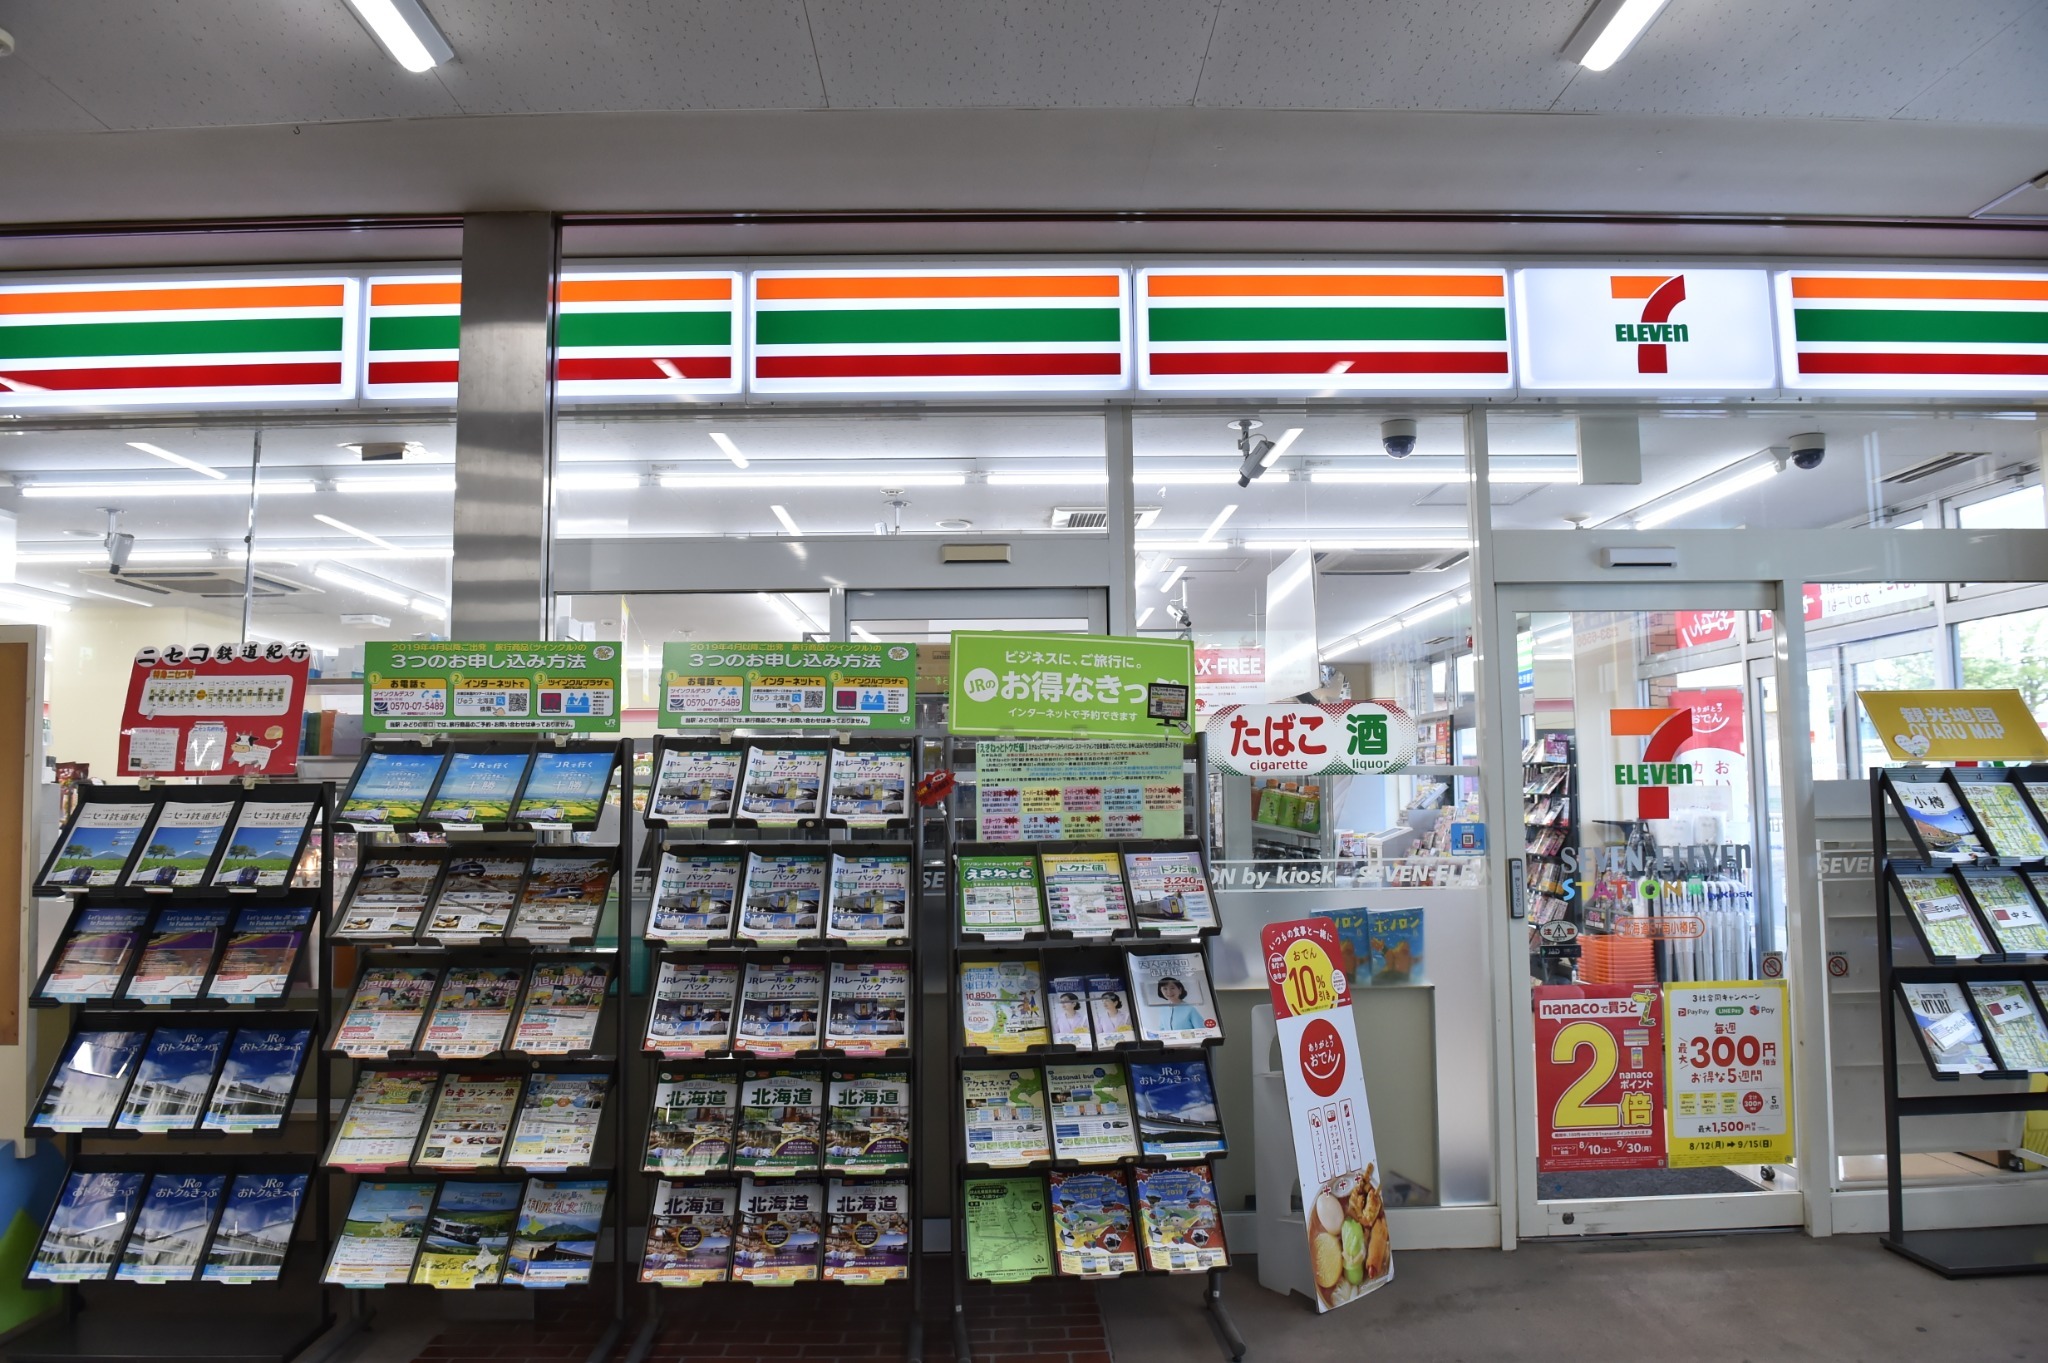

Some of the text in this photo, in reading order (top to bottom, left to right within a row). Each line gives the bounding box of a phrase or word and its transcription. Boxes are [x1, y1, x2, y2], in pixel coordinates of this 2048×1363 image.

[137, 644, 308, 664] ニセコ鉄道紀行
[689, 653, 881, 668] 3つのお申し込み方法
[1005, 650, 1143, 669] ビジネスに、ご旅行に。
[391, 654, 587, 669] 3つのお申し込み方法
[390, 680, 426, 688] お電話で
[464, 680, 524, 688] インターネットで
[548, 679, 609, 687] ツインクルプラザで
[687, 678, 722, 686] お電話で
[760, 678, 821, 686] インターネットで
[843, 677, 904, 685] ツインクルプラザで
[968, 677, 996, 693] JRの
[1000, 670, 1180, 704] お得なきっ
[686, 698, 740, 707] 0570-07-5489
[753, 694, 770, 702] びゅう
[390, 702, 444, 711] 0570-07-5489
[899, 716, 911, 724] JR
[1008, 707, 1138, 722] インターネットで予約できます
[1900, 706, 1999, 725] 観光地図
[605, 719, 615, 727] JR
[1230, 712, 1388, 756] たばこ 酒
[1909, 722, 2005, 740] OTARU MAP
[1250, 758, 1389, 771] cigarette liquor
[1914, 796, 1945, 809] 小樽
[1820, 857, 1874, 874] SEVE
[965, 868, 1033, 880] えきねっと
[1241, 866, 1271, 891] by
[1276, 866, 1334, 884] kiosk
[1163, 877, 1203, 885] 3,240円
[1561, 878, 1682, 901] STATION
[1935, 901, 1963, 914] English
[2010, 910, 2033, 919] 中文
[1374, 916, 1419, 933] ボノロン
[1623, 921, 1697, 936] 北海道ST南小樽店
[1269, 925, 1333, 950] いつもの食事と一緒に
[1293, 947, 1317, 961] おでん
[363, 979, 434, 989] 旭山動物園
[533, 975, 607, 988] 旭山動物園
[1318, 990, 1331, 1001] 引き
[1692, 994, 1760, 1002] 3社合同キャンペーン
[2003, 1001, 2024, 1013] 中文
[1714, 1022, 1736, 1034] 毎週
[1946, 1015, 1968, 1035] English
[182, 1034, 204, 1043] JRの
[265, 1034, 286, 1043] JRの
[1308, 1040, 1334, 1051] ありがとう
[1310, 1049, 1336, 1067] おでん
[1678, 1043, 1688, 1064] 最大
[1161, 1067, 1181, 1076] JRの
[1552, 1020, 1620, 1129] 2
[1691, 1068, 1762, 1083] お得な5週間
[1139, 1074, 1201, 1085] おトクなきっぷ
[1620, 1080, 1653, 1089] ポイント
[445, 1088, 515, 1098] 白老ランチの旅
[666, 1090, 727, 1105] 北海道
[752, 1088, 813, 1104] 北海道
[839, 1090, 899, 1105] 北海道
[1621, 1091, 1654, 1127] 倍
[1689, 1140, 1772, 1150] 8/12(月) 9/15(日)
[99, 1177, 120, 1187] JRの
[182, 1178, 202, 1188] JRの
[264, 1178, 284, 1188] JRの
[663, 1197, 725, 1214] 北海道
[748, 1195, 809, 1212] 北海道
[837, 1196, 898, 1211] 北海道
